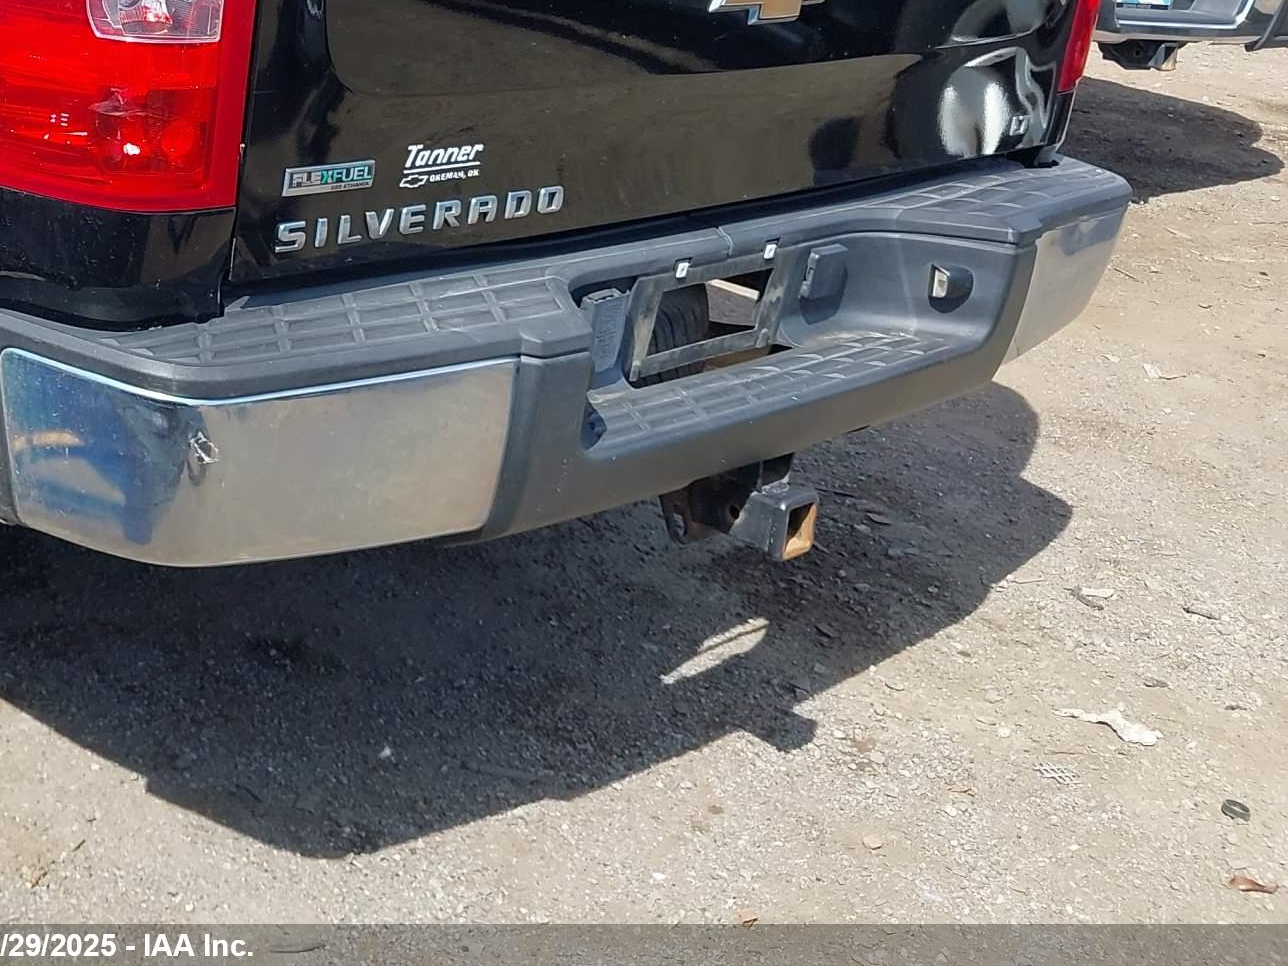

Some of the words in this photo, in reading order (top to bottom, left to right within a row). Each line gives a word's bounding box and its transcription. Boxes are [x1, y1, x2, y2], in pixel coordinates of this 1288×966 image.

[405, 144, 484, 168] Tanner
[292, 166, 372, 187] FLEXFUEL
[274, 185, 564, 253] SILVERADO
